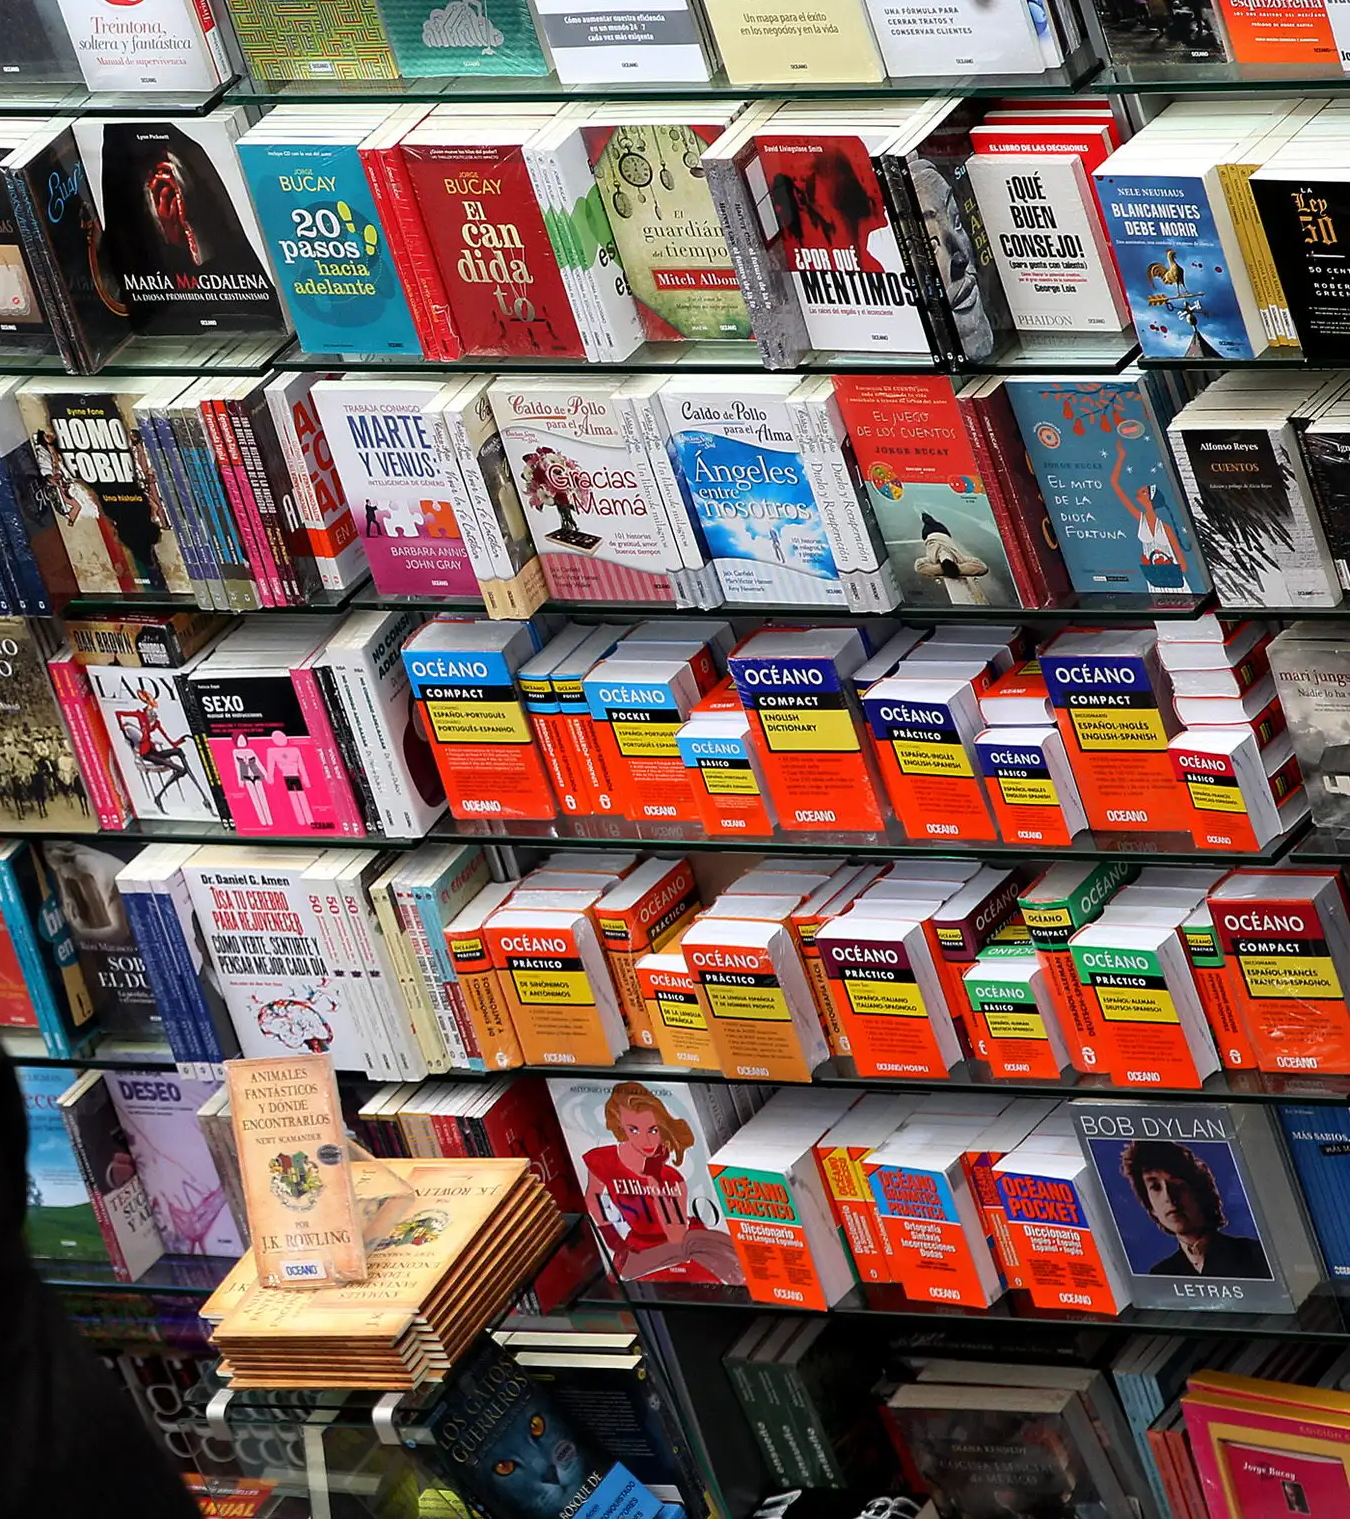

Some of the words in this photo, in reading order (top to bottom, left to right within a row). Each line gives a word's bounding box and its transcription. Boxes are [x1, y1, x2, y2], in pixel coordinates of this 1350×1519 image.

[744, 13, 755, 23] Un
[756, 14, 778, 26] mapa
[780, 13, 798, 25] para
[799, 13, 806, 22] el
[806, 11, 826, 22] éxito
[884, 8, 900, 16] UNA
[902, 5, 936, 15] FÓRMULA
[91, 15, 168, 36] Treintona,
[888, 17, 916, 26] CERRAR
[919, 17, 946, 25] TRATOS
[948, 16, 954, 24] Y
[891, 27, 933, 36] CONSERVAR
[935, 26, 973, 35] CLIENTES
[80, 35, 118, 52] soltera
[121, 40, 130, 53] y
[132, 34, 192, 54] fantástica
[96, 56, 124, 67] Manual
[125, 57, 134, 66] de
[135, 56, 187, 68] supervivencia
[279, 176, 337, 192] BUCAY
[1006, 171, 1046, 203] ¡QUÉ
[1118, 188, 1140, 197] NELE
[1142, 189, 1184, 198] NEUHAUS
[674, 210, 683, 219] El
[1012, 206, 1057, 230] BUEN
[1112, 203, 1201, 220] BLANCANIEVES
[291, 209, 341, 238] 20
[642, 218, 724, 243] guardián
[1125, 221, 1156, 236] DEBE
[1161, 223, 1198, 237] MORIR
[279, 238, 360, 263] pasos
[652, 250, 664, 258] del
[666, 244, 728, 265] tiempo
[1000, 234, 1084, 259] CONSEJO!
[794, 249, 829, 270] ¿POR
[833, 245, 859, 271] QUÉ
[316, 260, 369, 277] hacia
[125, 273, 175, 290] MARÍA
[176, 274, 268, 289] MAGDALENA
[658, 272, 695, 286] Mitch
[699, 273, 738, 286] Albom
[294, 281, 375, 296] adelante
[1035, 284, 1058, 293] George
[132, 293, 140, 301] LA
[140, 293, 165, 302] DIOSA
[166, 292, 203, 301] PROHIBIDA
[204, 293, 218, 301] DEL
[1018, 315, 1073, 327] PHAIDON
[52, 417, 128, 448] HOMO
[347, 415, 431, 449] MARTE
[1201, 442, 1230, 451] Alfonso
[1232, 443, 1258, 452] Reyes
[61, 453, 134, 483] FOBIA
[358, 453, 374, 477] Y
[374, 452, 441, 479] VENUS:
[695, 451, 798, 490] Ángeles
[1211, 462, 1259, 473] CUENTOS
[548, 465, 638, 490] Gracias
[1048, 476, 1065, 489] EL
[1070, 480, 1102, 490] MITO
[699, 488, 739, 500] entre
[1055, 495, 1070, 505] DE
[1074, 497, 1091, 505] LA
[570, 494, 648, 517] Mamá
[705, 498, 812, 520] nosotros
[1061, 512, 1097, 523] DIOSA
[1066, 526, 1127, 540] FORTUNA
[391, 546, 432, 558] BARBARA
[435, 548, 467, 558] ANNIS
[405, 559, 434, 571] JOHN
[436, 559, 462, 571] GRAY
[74, 629, 96, 652] DAN
[97, 632, 134, 654] BROWN
[412, 658, 488, 678] OCÉANO
[745, 663, 823, 685] OCÉANO
[96, 675, 177, 700] LADY
[426, 689, 483, 698] COMPACT
[202, 696, 244, 712] SEXO
[759, 696, 818, 706] COMPACT
[764, 713, 799, 722] ENGLISH
[880, 703, 944, 725] OCÉANO
[768, 722, 817, 732] DICTIONARY
[1082, 732, 1158, 741] ENGLISH-SPANISH
[462, 800, 501, 812] OCEANO
[201, 875, 214, 884] Dr.
[216, 875, 248, 885] Daniel
[249, 876, 259, 885] G.
[262, 875, 290, 886] Amen
[213, 888, 233, 909] USA
[232, 890, 248, 910] TU
[246, 891, 289, 910] CEREBRO
[212, 911, 239, 930] PARA
[238, 912, 303, 935] REJUVENECER
[212, 933, 241, 954] CÓMO
[270, 936, 313, 955] SENTIRTE
[310, 937, 320, 956] Y
[501, 934, 566, 952] OCÉANO
[218, 956, 254, 974] PENSAR
[253, 956, 288, 975] MEJOR
[286, 957, 310, 976] CADA
[310, 956, 329, 976] DÍA
[250, 1068, 308, 1083] ANIMALES
[121, 1081, 181, 1102] DESEO
[245, 1083, 318, 1099] FANTÁSTICOS
[258, 1103, 266, 1114] Y
[243, 1114, 330, 1130] ENCONTRARLOS
[1080, 1115, 1134, 1136] BOB
[1142, 1117, 1226, 1139] DYLAN
[1002, 1172, 1074, 1202] OCÉANO
[1010, 1200, 1078, 1224] POCKET
[1024, 1226, 1080, 1240] Diccionario
[262, 1236, 283, 1253] J.K.
[286, 1230, 351, 1246] ROWLING
[286, 1265, 317, 1276] OCEANO
[1174, 1283, 1244, 1298] LETRAS
[1243, 1461, 1265, 1474] Jorge
[1269, 1467, 1297, 1481] Bucay
